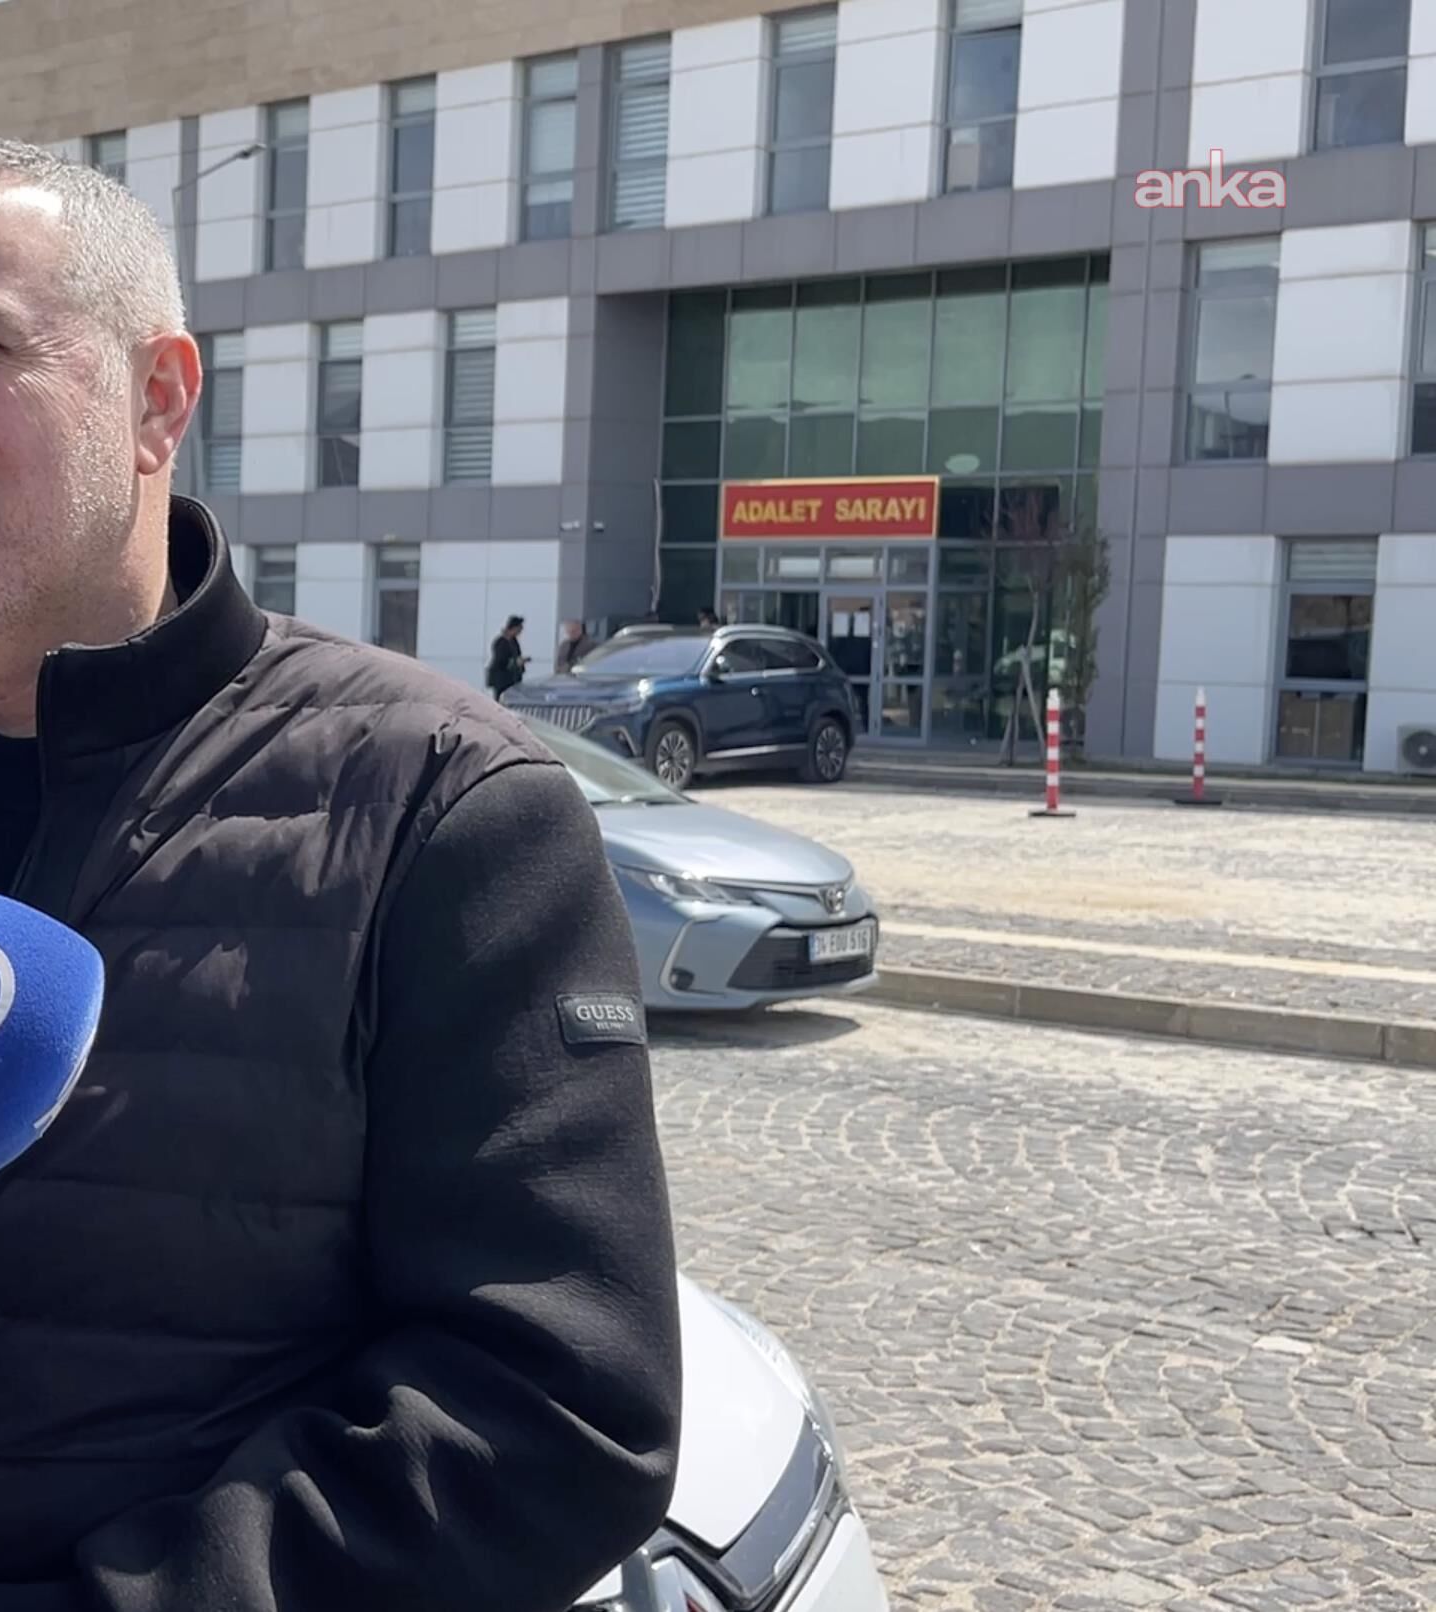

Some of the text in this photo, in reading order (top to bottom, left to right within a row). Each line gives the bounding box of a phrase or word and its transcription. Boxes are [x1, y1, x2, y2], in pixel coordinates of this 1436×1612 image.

[732, 498, 926, 523] ADALET SARAYI
[575, 1004, 635, 1021] GUESS
